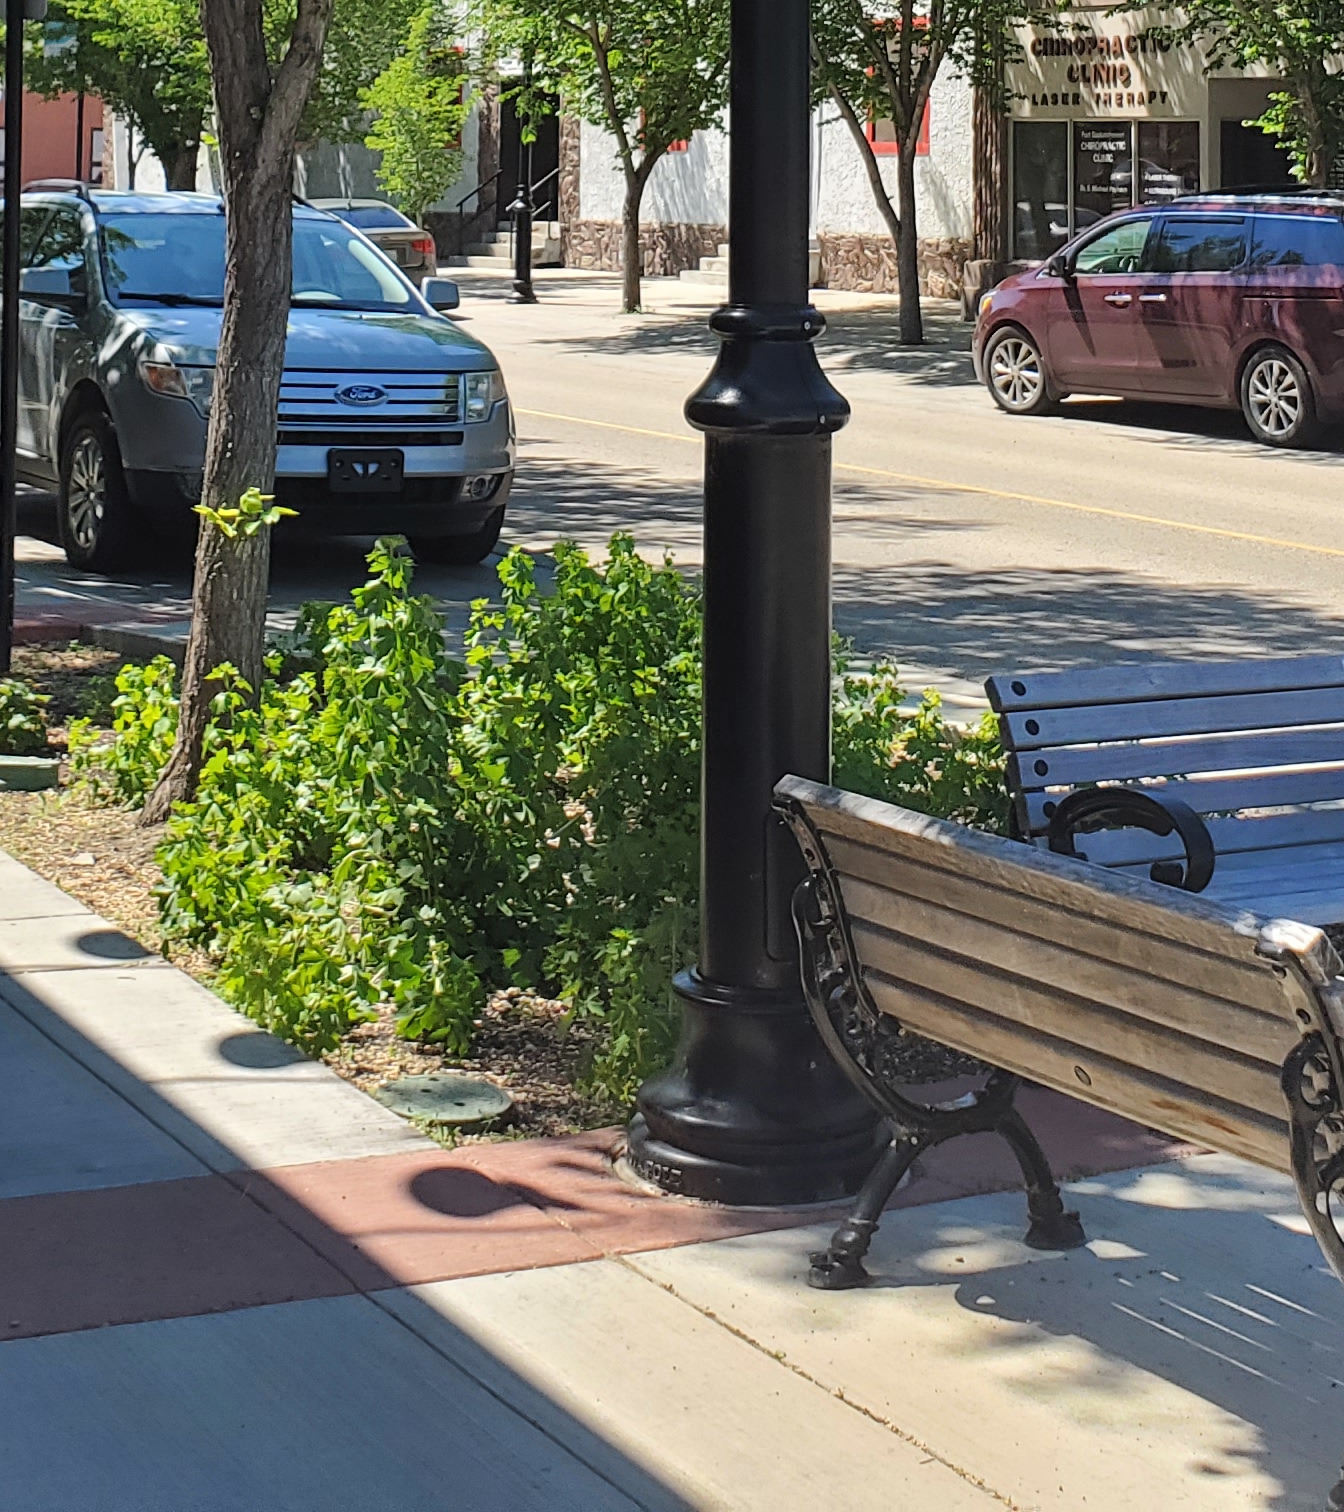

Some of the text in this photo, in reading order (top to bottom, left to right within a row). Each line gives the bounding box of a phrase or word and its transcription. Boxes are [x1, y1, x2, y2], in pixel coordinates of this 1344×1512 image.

[1066, 62, 1131, 88] CLINIC
[1031, 91, 1168, 108] LASER THERAPY
[348, 386, 377, 399] Ford
